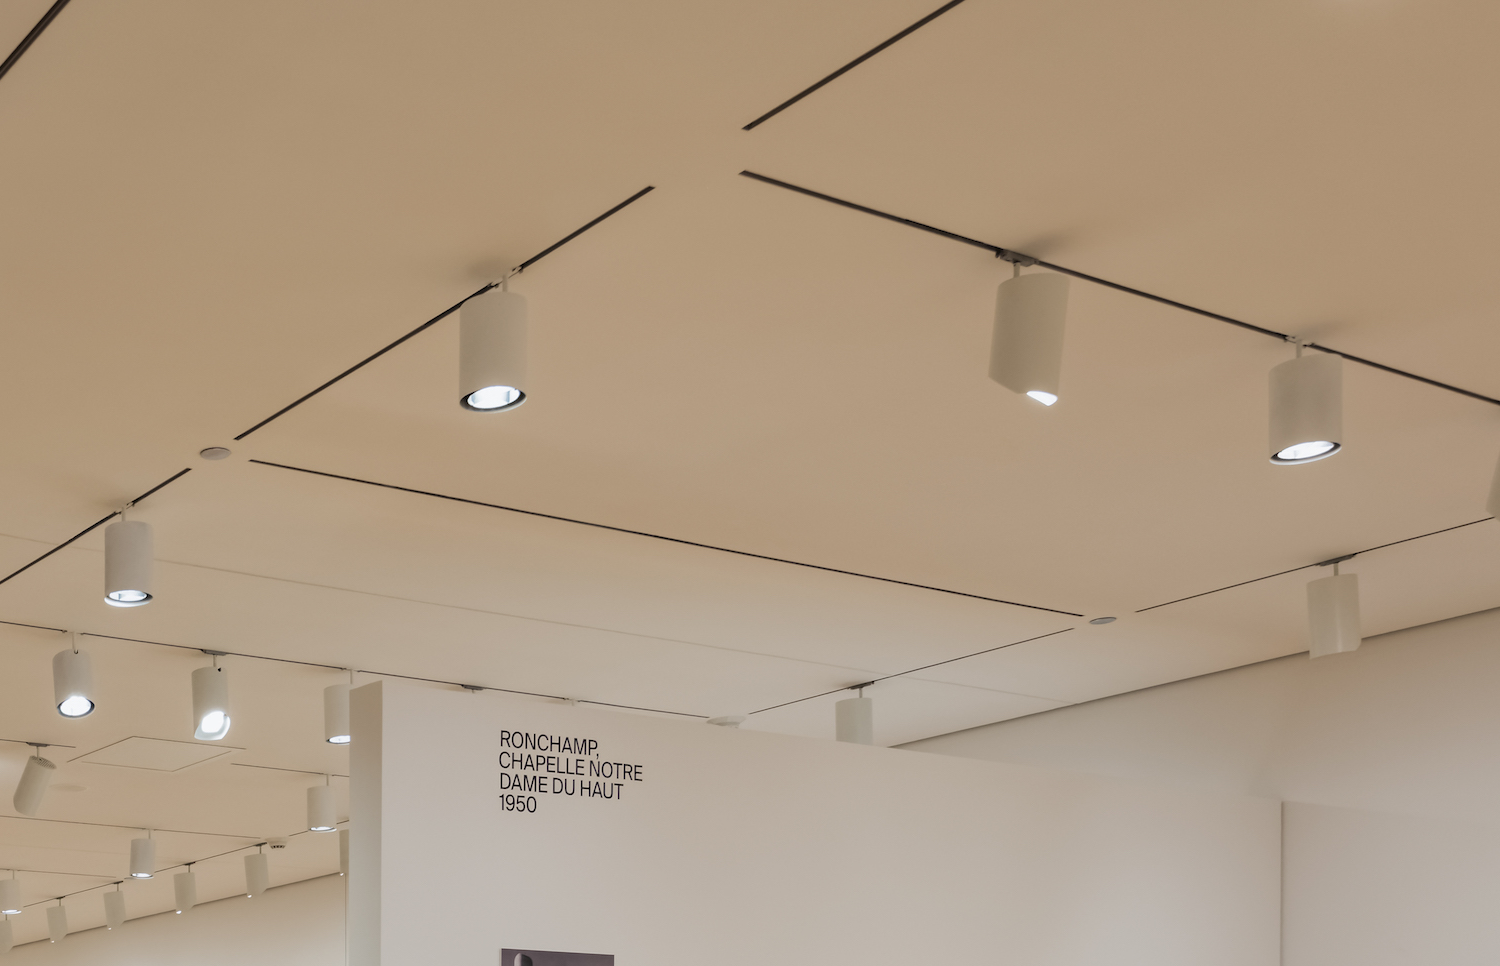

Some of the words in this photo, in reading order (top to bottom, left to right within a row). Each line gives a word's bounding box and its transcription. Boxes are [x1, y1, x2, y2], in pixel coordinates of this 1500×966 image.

[500, 730, 599, 759] RONCHAMP,
[499, 751, 585, 776] CHAPELLE
[590, 760, 643, 782] NOTRE
[500, 772, 548, 793] DAME
[553, 777, 576, 796] DU
[581, 780, 624, 800] HAUT
[499, 793, 537, 813] 1950
